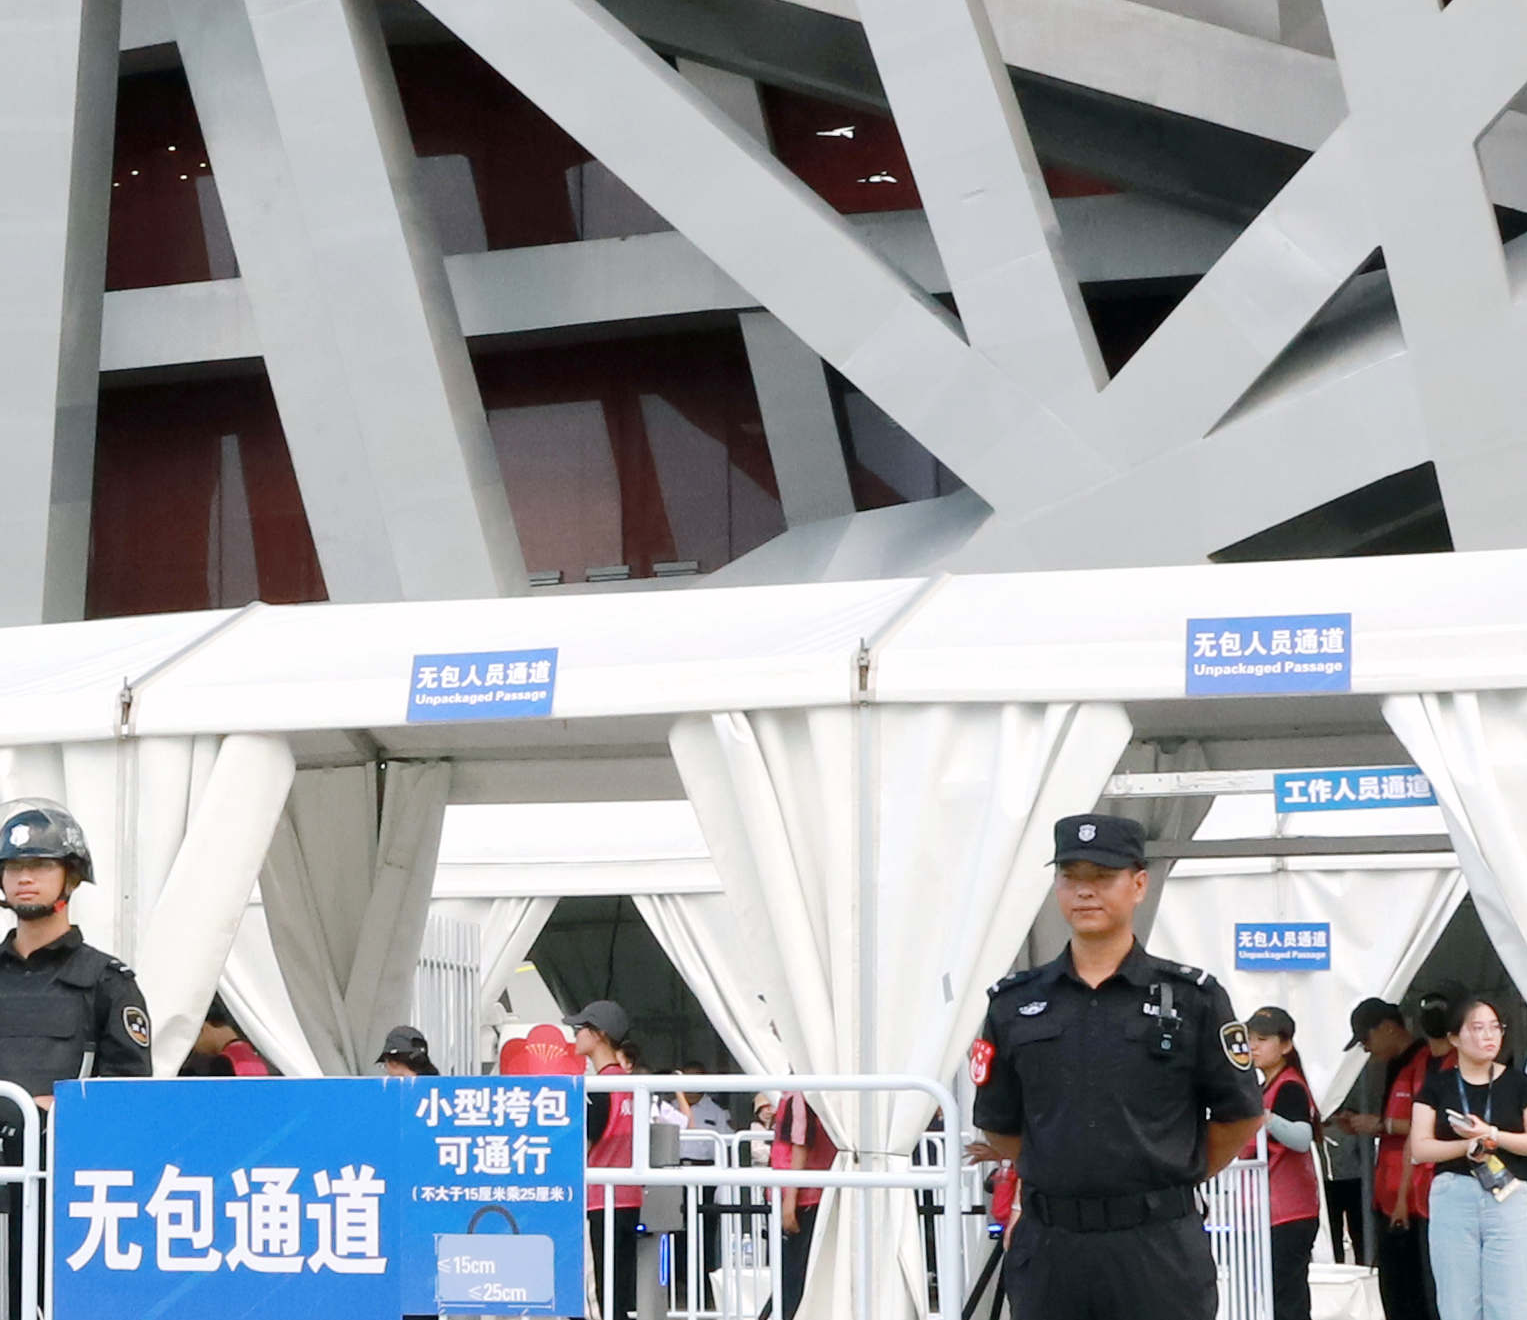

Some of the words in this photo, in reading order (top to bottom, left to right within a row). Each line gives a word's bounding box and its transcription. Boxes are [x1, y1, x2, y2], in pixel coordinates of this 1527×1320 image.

[1194, 628, 1345, 658] 无包人员通道
[416, 660, 552, 689] 无包人员通道
[1194, 661, 1281, 676] Unpackaged
[1285, 661, 1342, 674] Passage
[415, 691, 493, 706] Unpackaged
[496, 690, 547, 702] Passage
[1284, 775, 1432, 804] 工作人员通道
[1238, 931, 1327, 947] 无包人员通道
[416, 1087, 571, 1127] 小型挎包
[435, 1136, 551, 1175] 可通行
[67, 1164, 388, 1276] 无包通道
